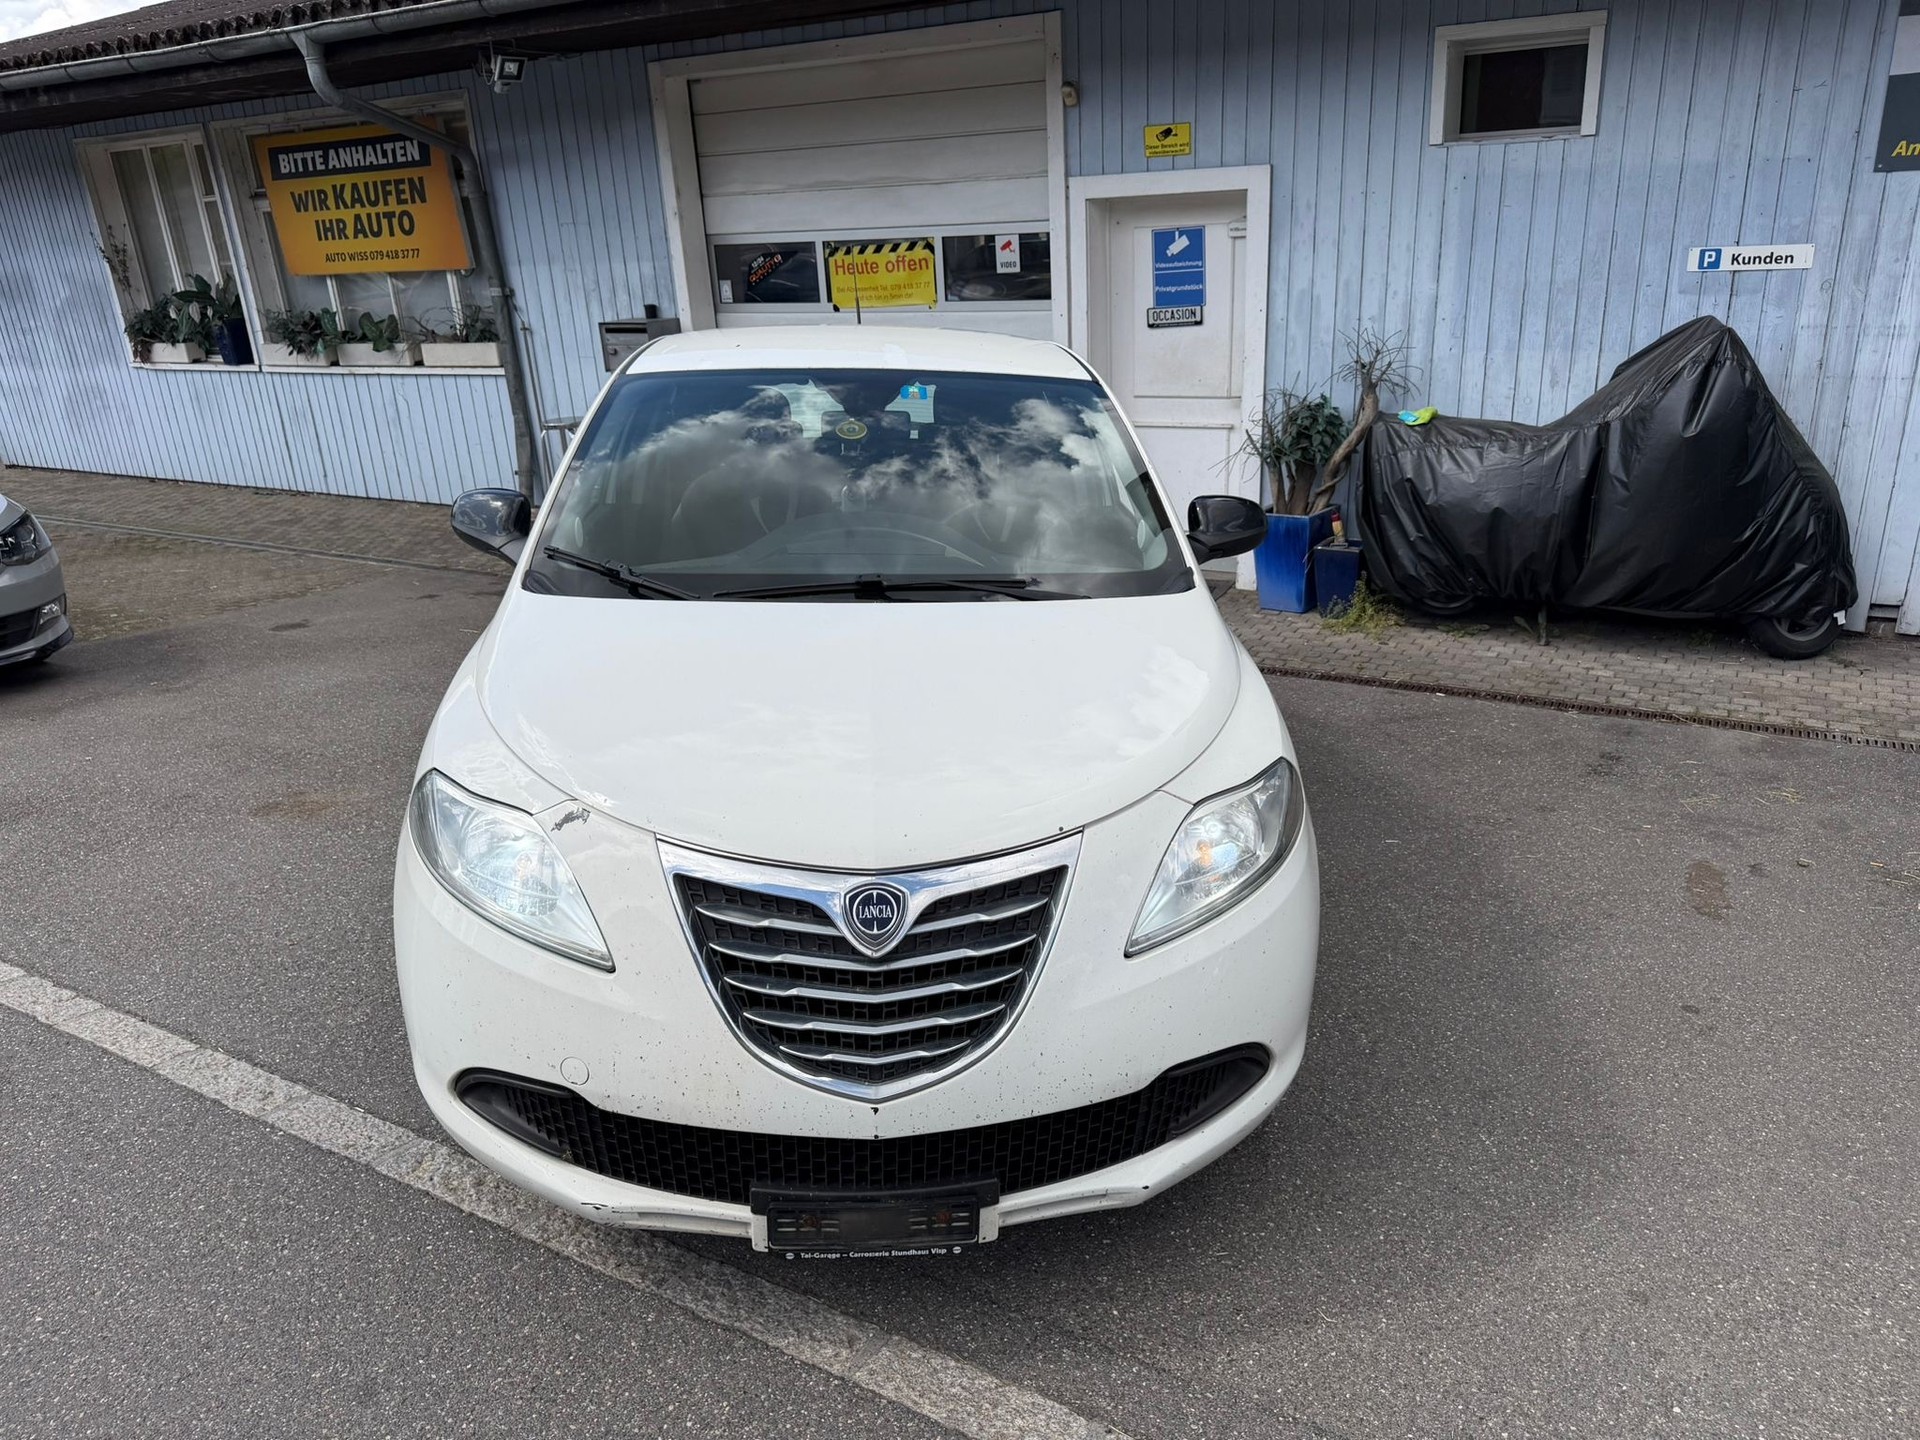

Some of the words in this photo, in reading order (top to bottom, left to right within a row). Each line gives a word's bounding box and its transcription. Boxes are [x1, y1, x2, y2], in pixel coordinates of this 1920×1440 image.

[278, 150, 325, 174] BITTE
[328, 139, 421, 169] ANHALTEN
[290, 188, 331, 213] WIR
[331, 176, 428, 211] KAUFEN
[314, 217, 350, 242] IHR
[353, 210, 416, 240] AUTO
[325, 252, 347, 263] AUTO
[347, 251, 369, 262] WISS
[369, 249, 385, 261] 079
[385, 249, 400, 260] 418
[400, 248, 410, 259] 37
[410, 247, 420, 259] 77
[1703, 251, 1716, 268] P
[1730, 252, 1794, 266] Kunden
[834, 258, 880, 276] Heute
[885, 255, 929, 273] offen
[1152, 308, 1197, 322] OCCASION
[859, 905, 892, 918] LANCIA
